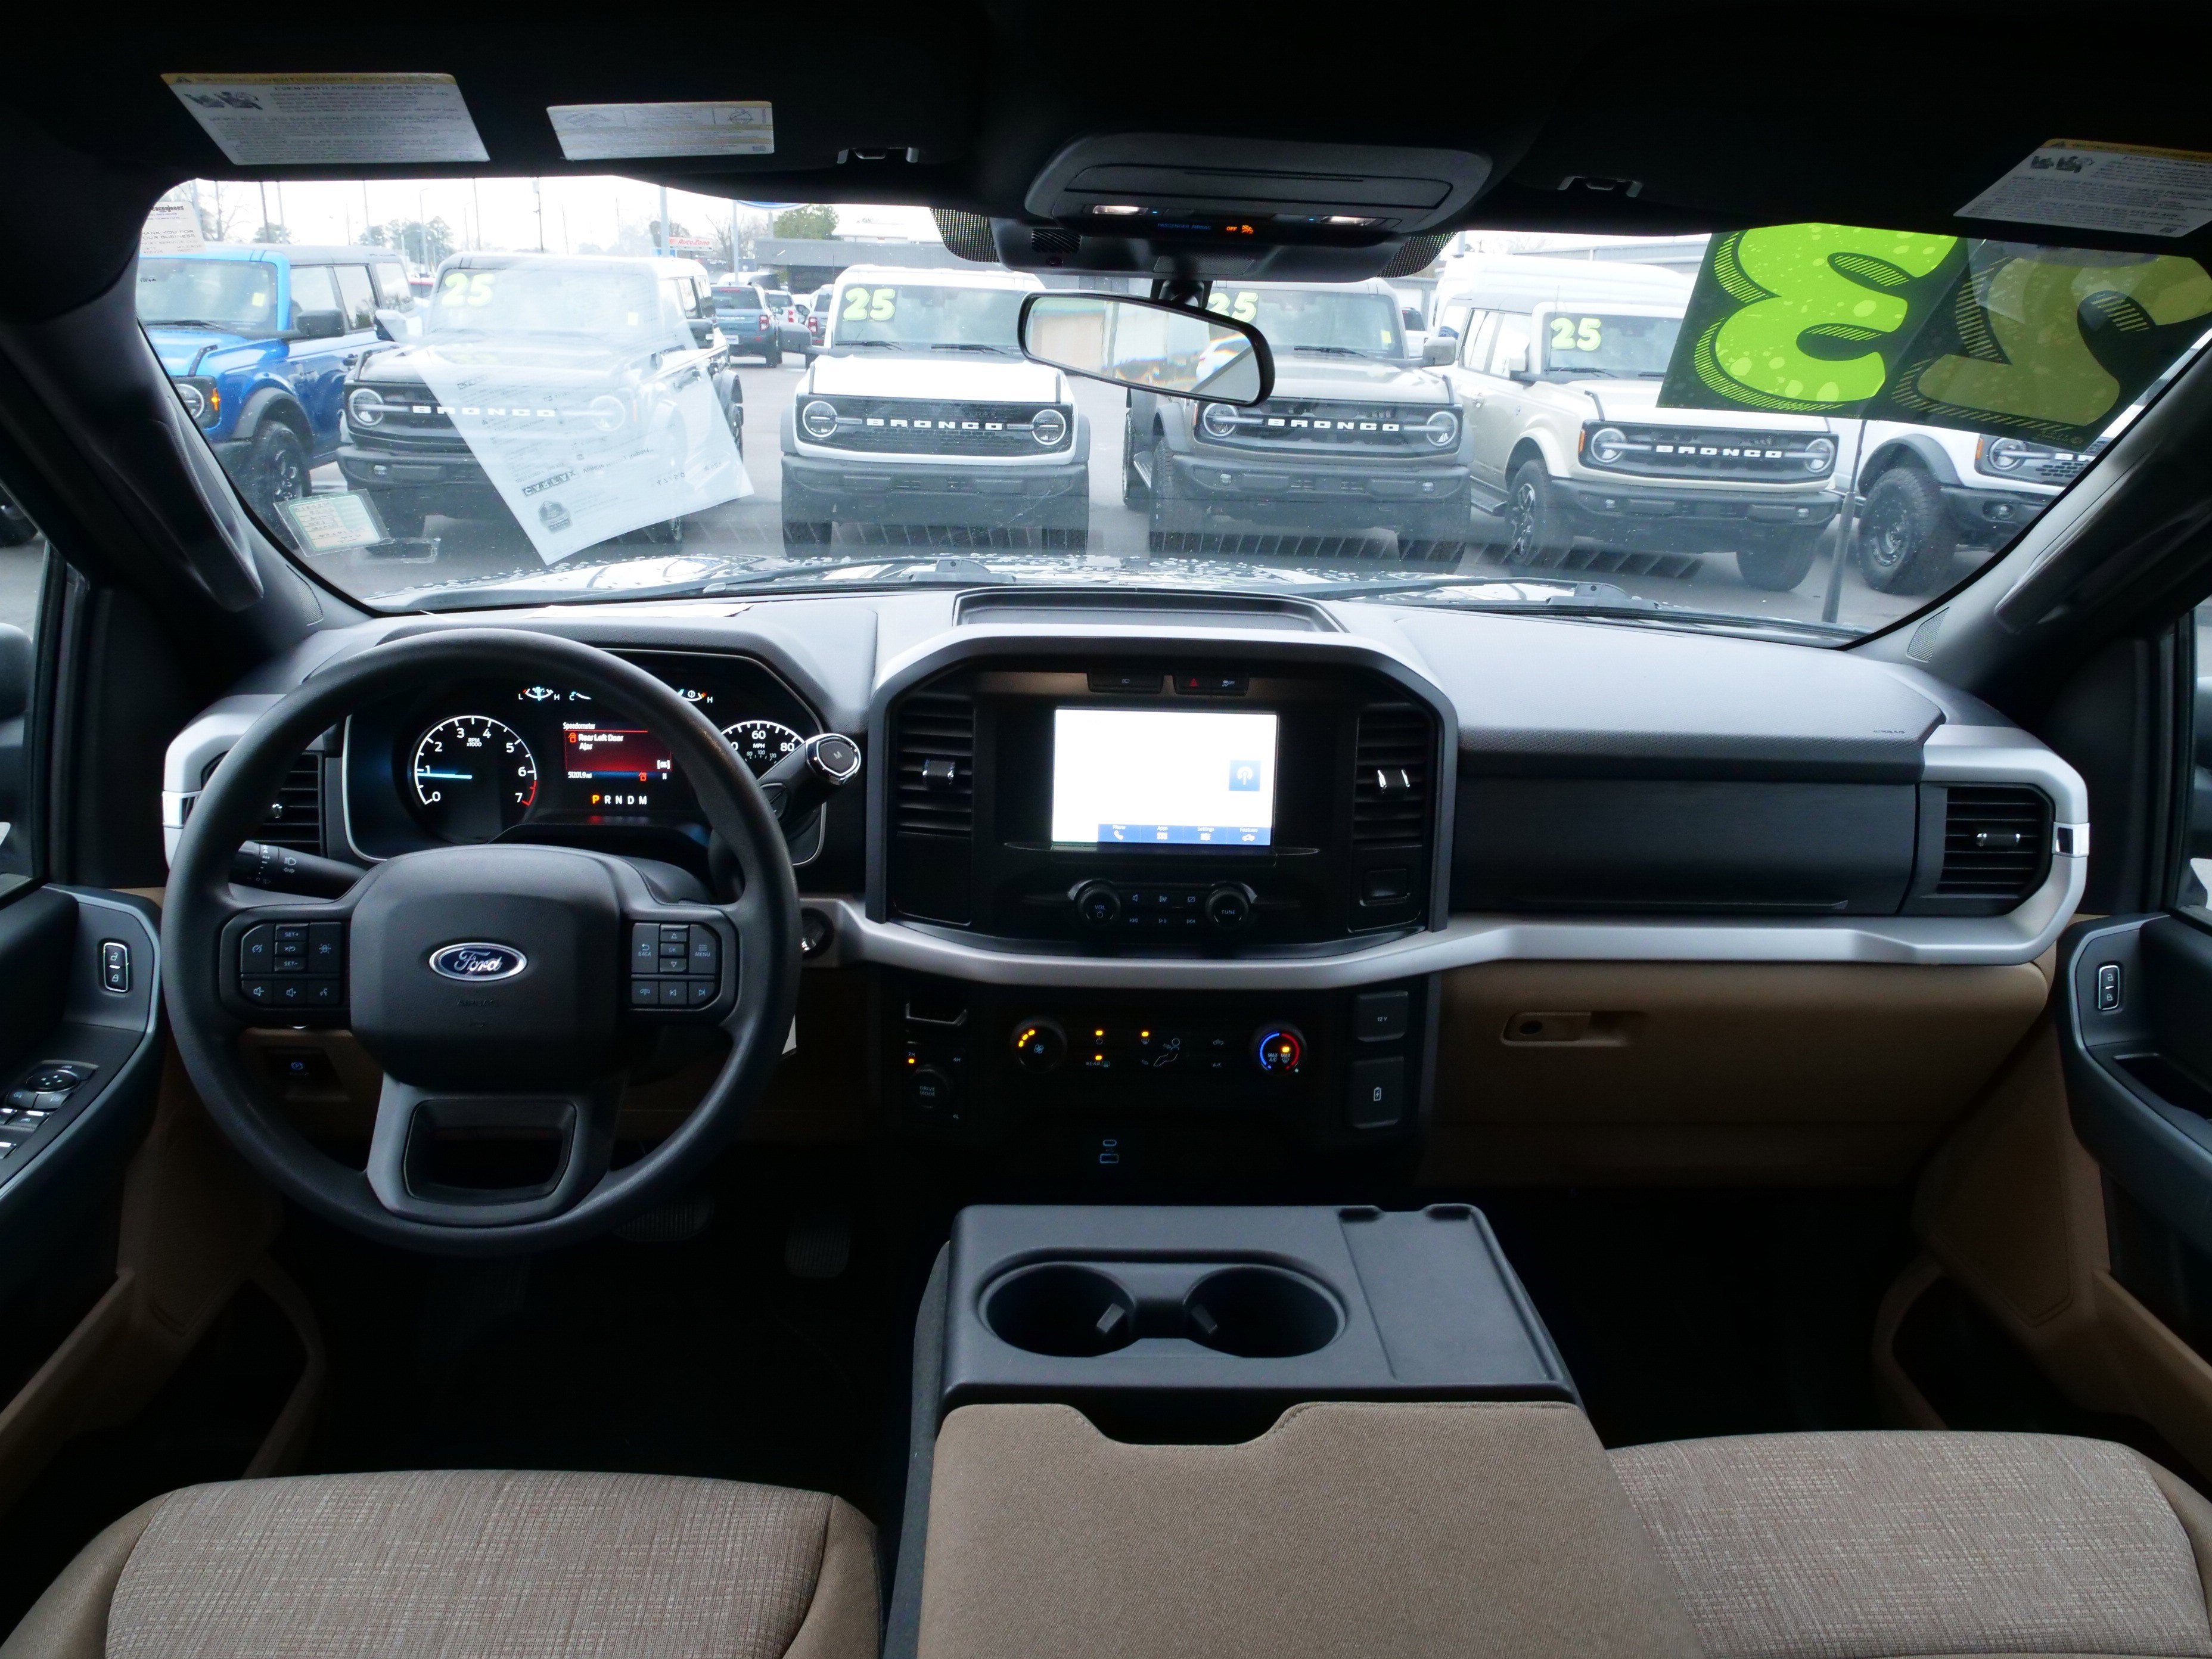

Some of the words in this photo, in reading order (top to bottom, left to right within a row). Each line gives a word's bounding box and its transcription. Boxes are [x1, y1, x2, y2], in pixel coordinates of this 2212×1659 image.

[442, 272, 496, 307] 25
[843, 287, 896, 322] 25
[1205, 291, 1259, 322] 25
[1550, 317, 1602, 352] 25
[412, 406, 555, 417] BRONCO
[866, 418, 1003, 431] BRONCO
[1267, 418, 1400, 431] BRONCO
[1655, 445, 1783, 459] BRONCO
[456, 728, 465, 738] 3
[482, 728, 492, 738] 4
[578, 733, 594, 741] Rear
[608, 734, 624, 742] Door
[751, 730, 766, 740] 60
[434, 742, 443, 752] 2
[506, 742, 514, 753] 5
[579, 742, 593, 751] Ajar
[780, 742, 795, 751] 80
[425, 765, 430, 774] 1
[518, 766, 527, 776] 6
[432, 791, 441, 801] 0
[515, 793, 523, 803] 7
[592, 794, 599, 804] P
[604, 795, 611, 804] R
[615, 795, 623, 804] N
[627, 796, 635, 804] D
[639, 796, 647, 805] M
[453, 950, 504, 973] Ford
